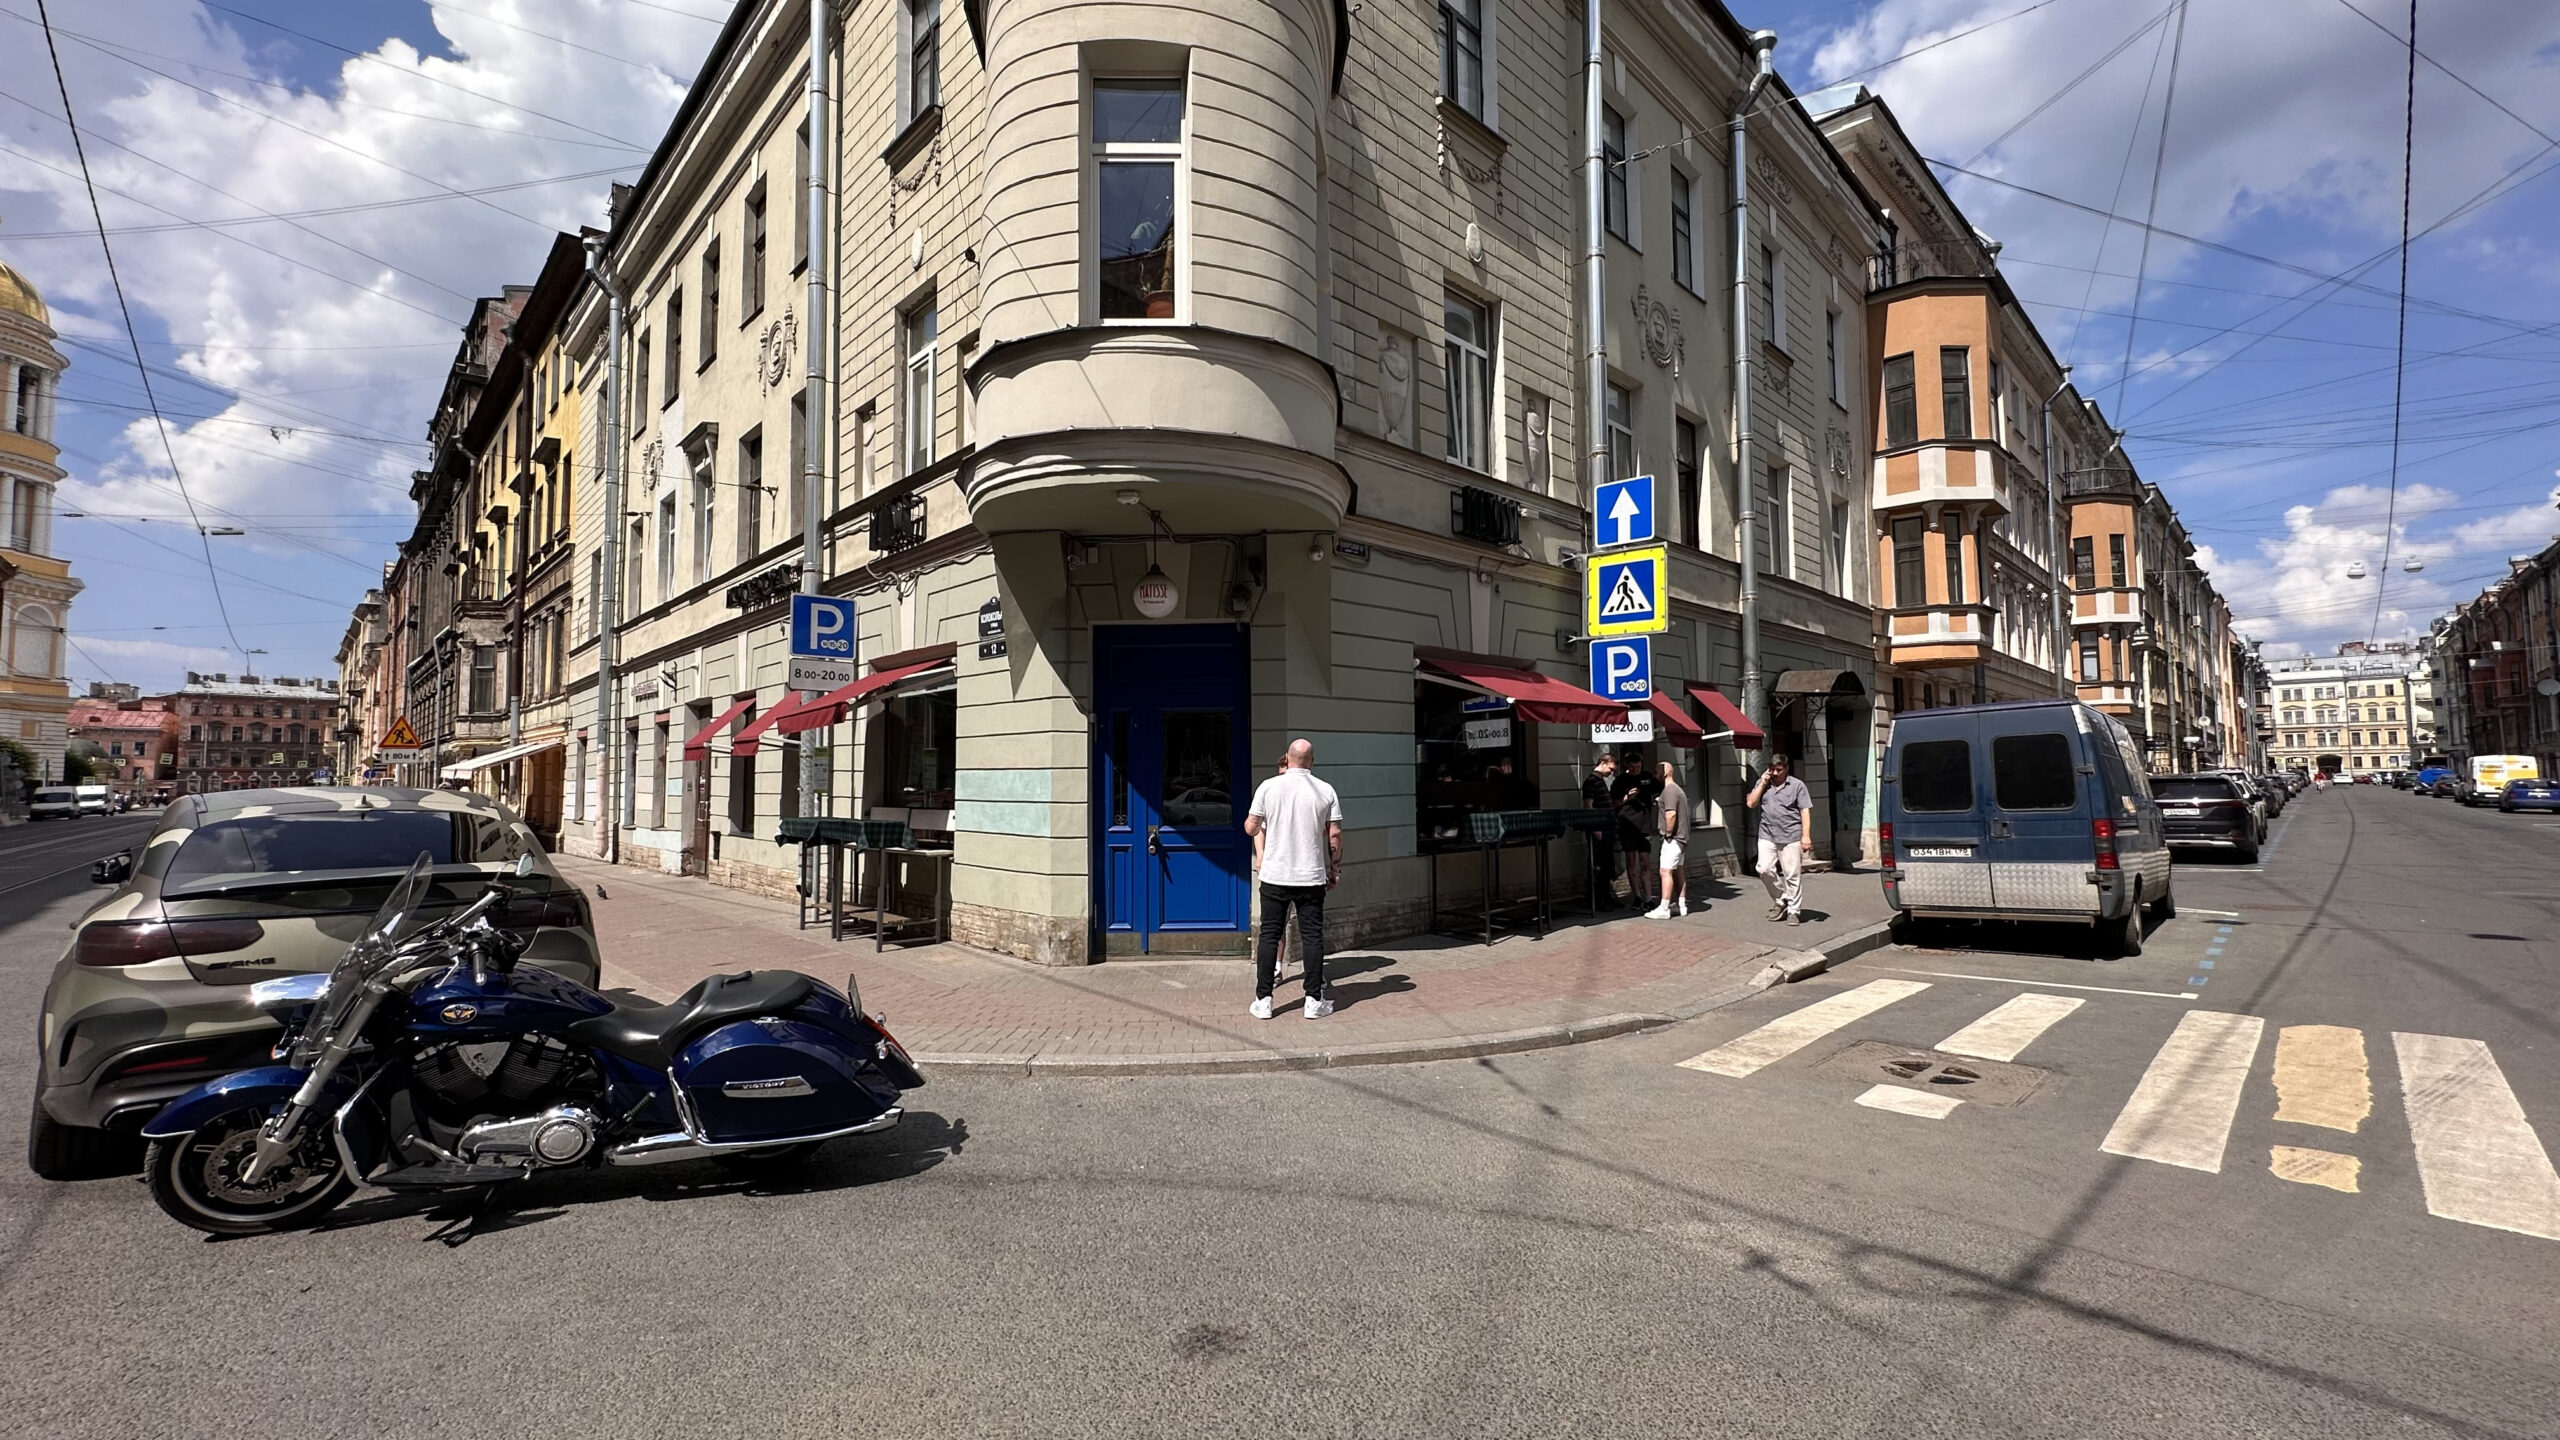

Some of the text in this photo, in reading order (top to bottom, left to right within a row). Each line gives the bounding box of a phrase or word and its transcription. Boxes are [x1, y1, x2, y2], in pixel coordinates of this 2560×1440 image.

[1140, 584, 1168, 599] MATISSE
[810, 603, 845, 649] P
[838, 642, 848, 650] 20
[990, 643, 998, 655] 12
[794, 668, 850, 682] 8.00-20.00
[1606, 646, 1639, 695] P
[1637, 682, 1646, 690] 20
[1594, 721, 1650, 733] 8.00-20.00
[229, 957, 276, 967] AMG
[742, 1081, 785, 1089] VICTORY
